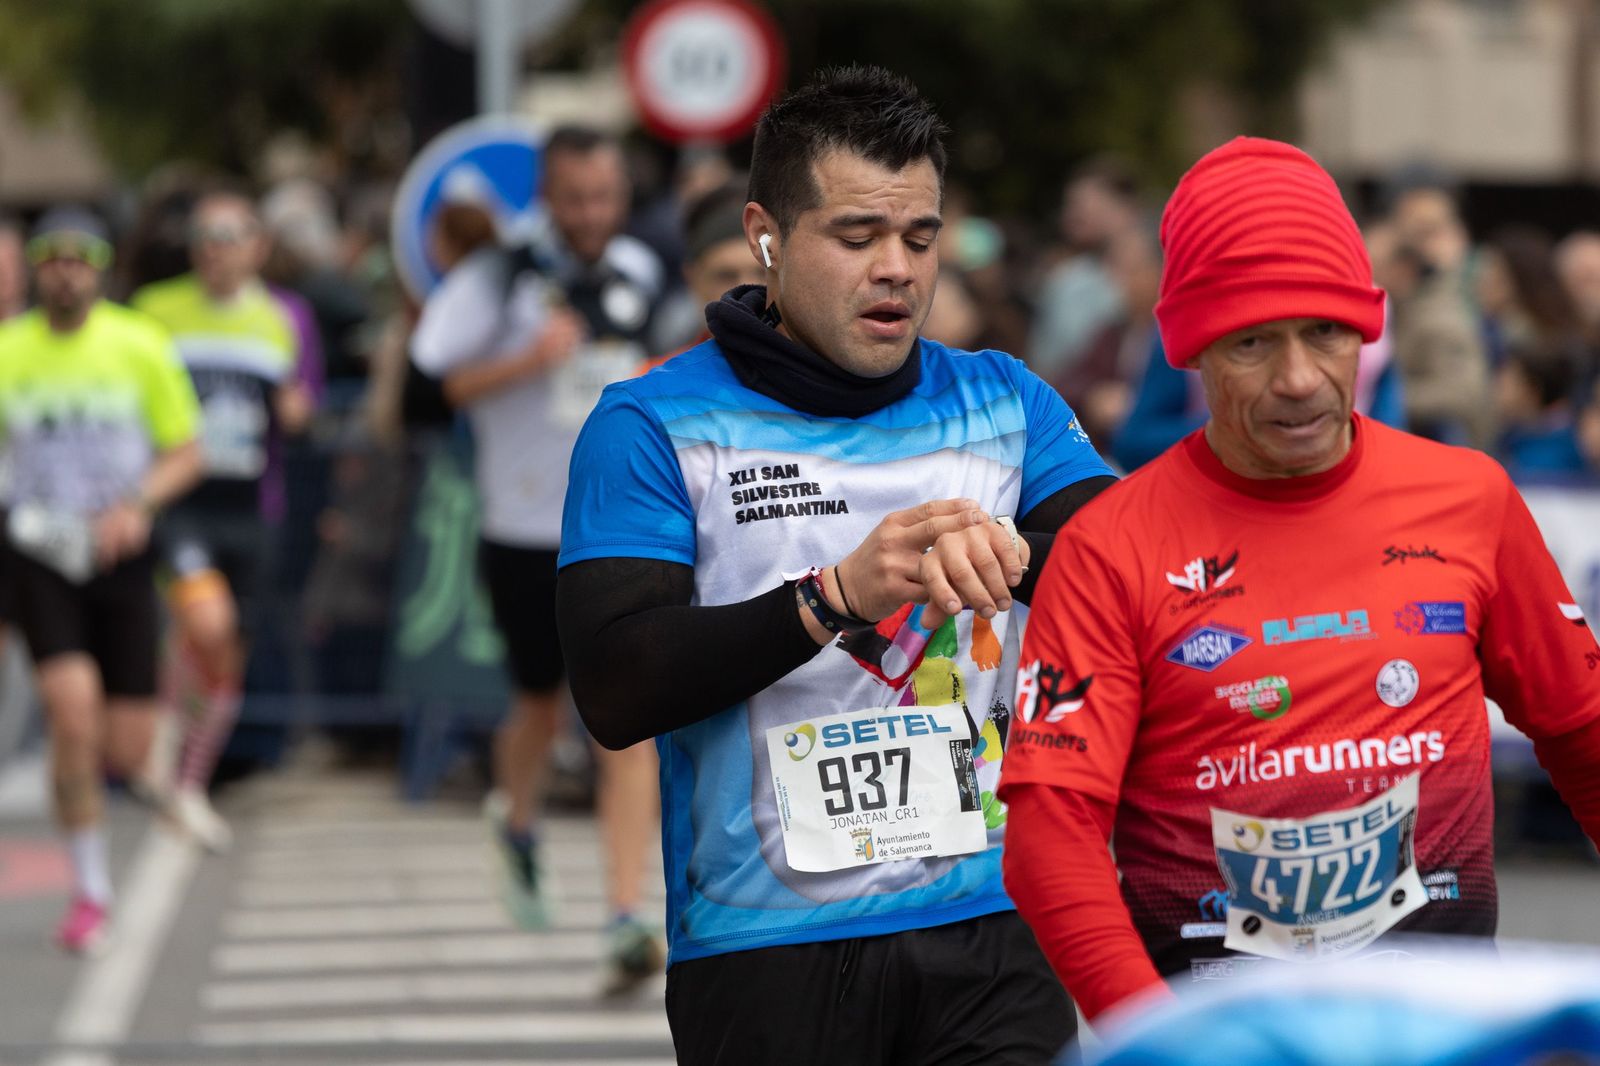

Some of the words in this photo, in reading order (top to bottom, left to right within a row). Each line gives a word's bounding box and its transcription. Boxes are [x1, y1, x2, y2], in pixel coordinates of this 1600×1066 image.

[728, 468, 757, 486] XLI
[761, 464, 799, 480] SAN
[731, 482, 822, 505] SILVESTRE
[735, 500, 849, 525] SALMANTINA
[1182, 633, 1232, 664] MARSAN
[821, 714, 952, 748] SETEL
[1012, 730, 1088, 753] unners
[817, 747, 911, 817] 937
[829, 807, 920, 830] JONATAN_CR1
[1271, 800, 1404, 850] SETEL
[876, 831, 930, 846] Ayuntamiento
[879, 848, 889, 857] de
[890, 843, 932, 855] Salamanca
[1251, 836, 1383, 914] 4722
